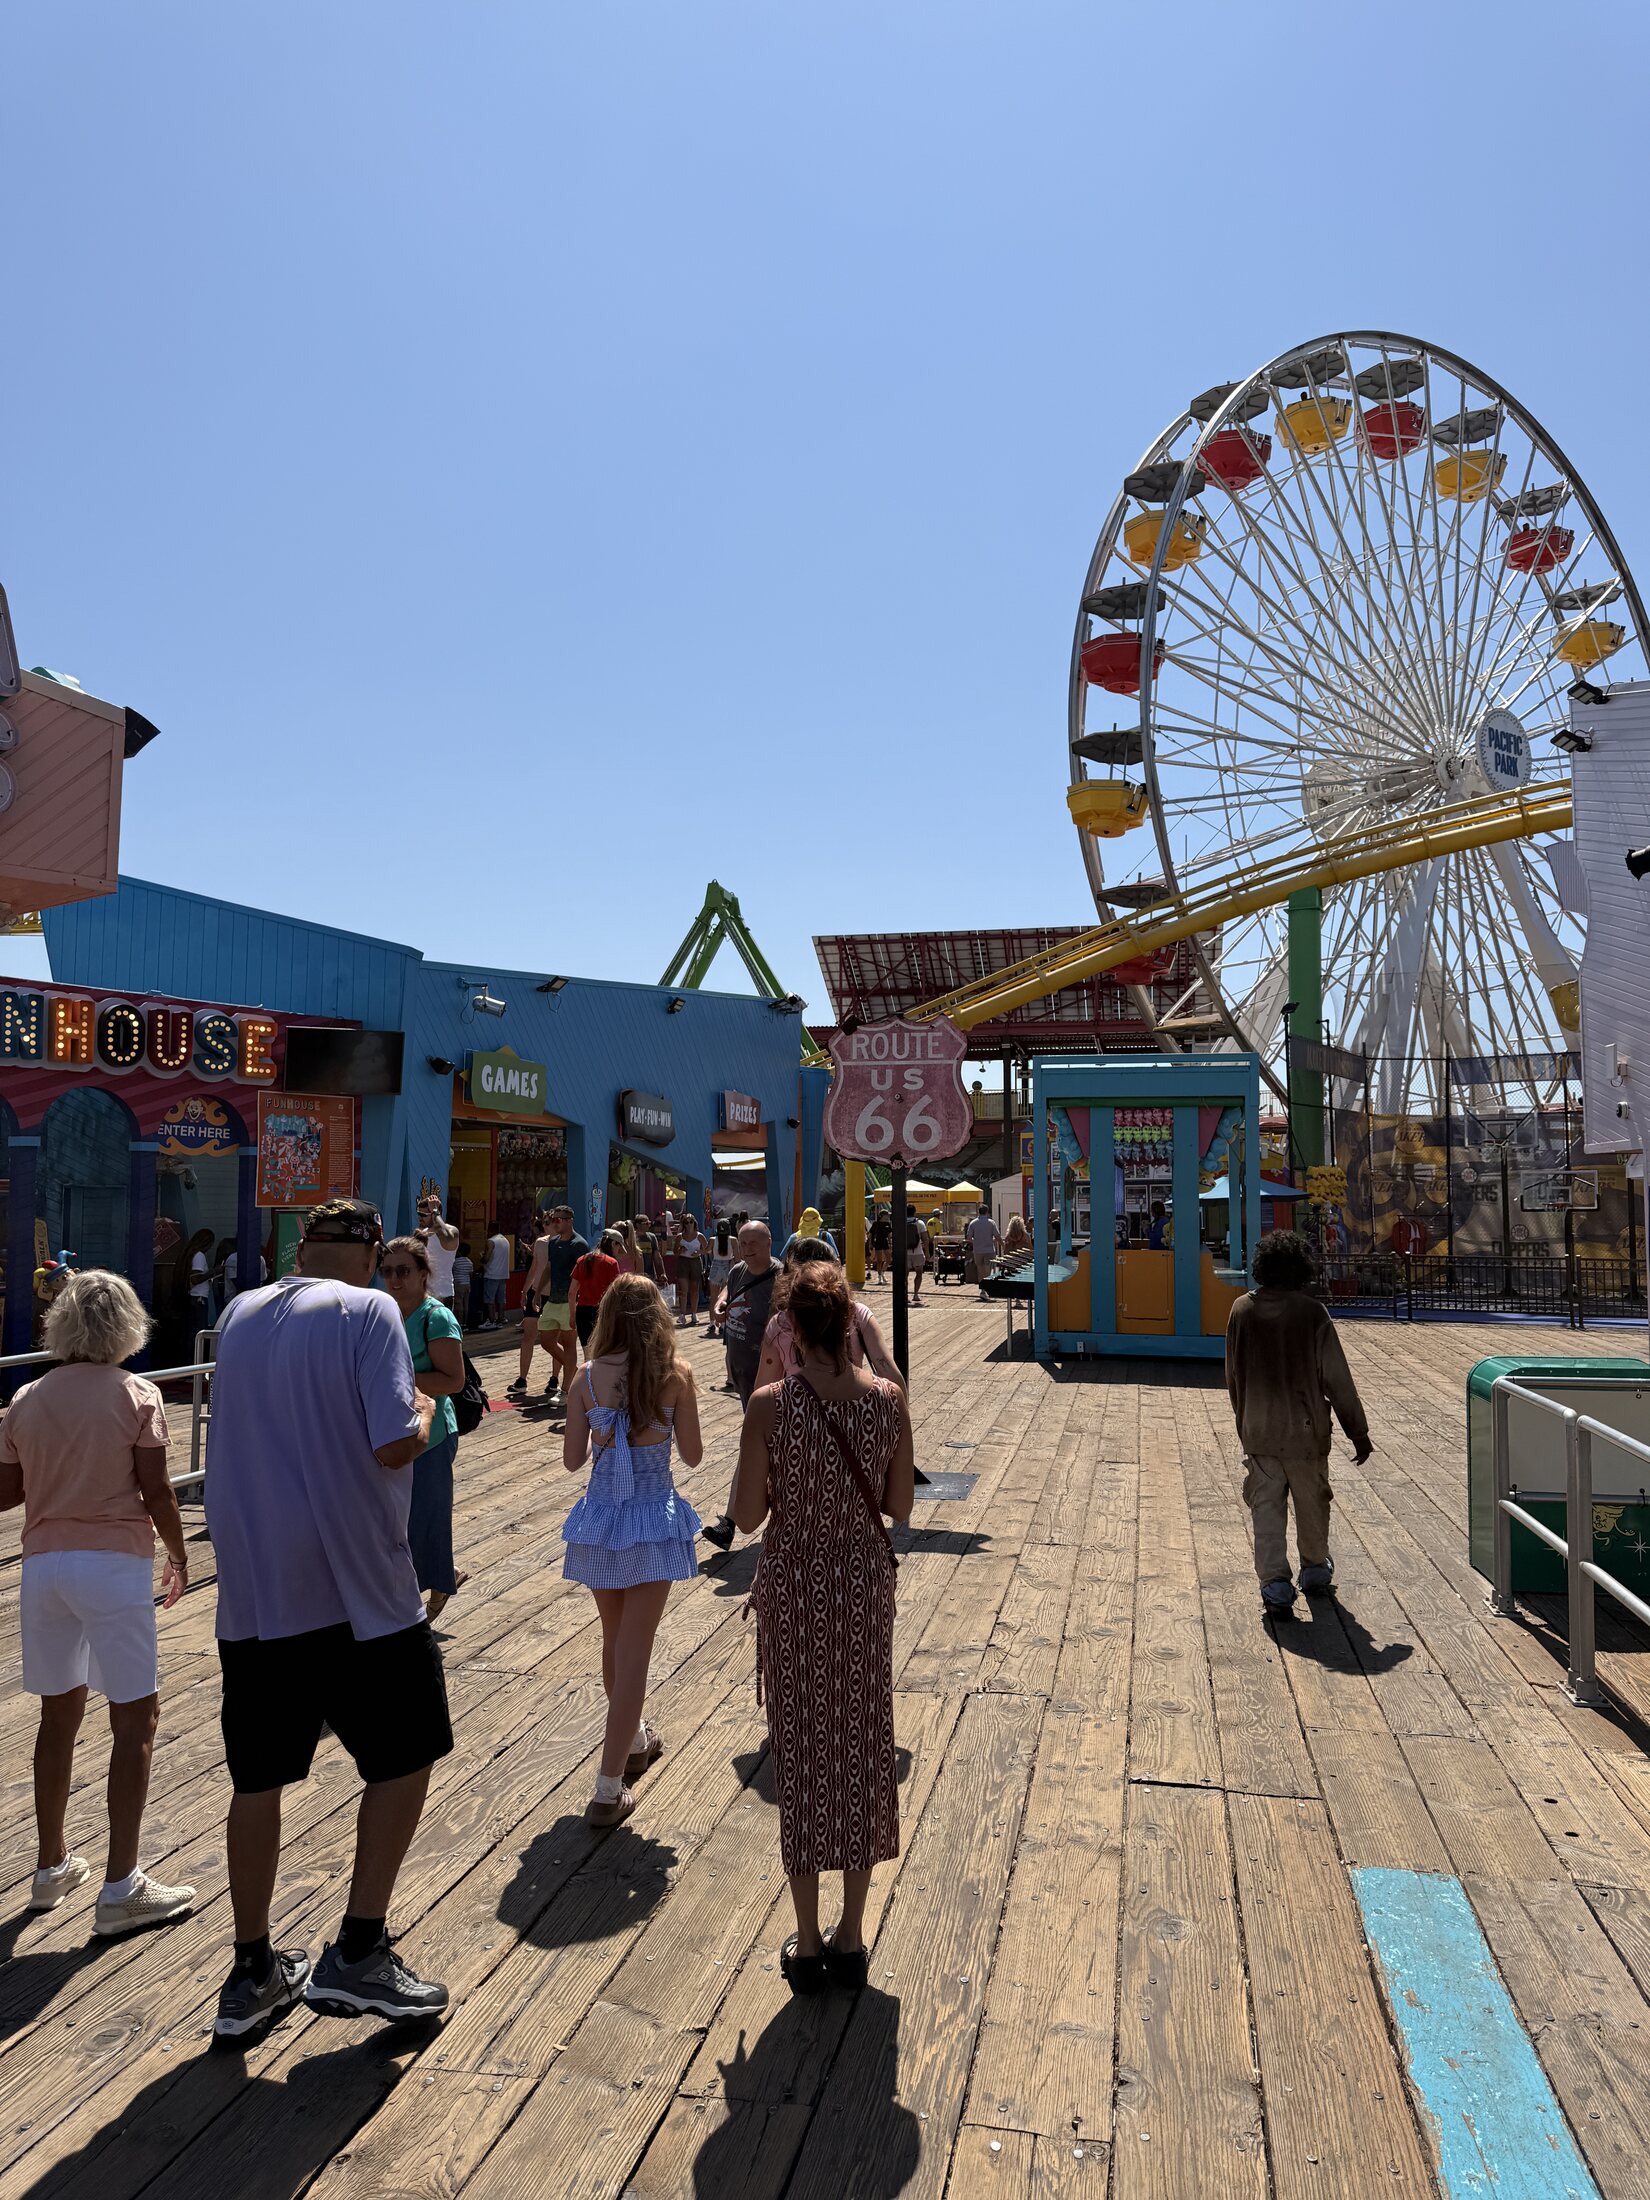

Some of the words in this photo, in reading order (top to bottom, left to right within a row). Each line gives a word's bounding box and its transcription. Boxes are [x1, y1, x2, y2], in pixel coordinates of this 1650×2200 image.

[1488, 727, 1523, 756] PACIFIC
[1494, 751, 1519, 778] PARK
[852, 1032, 944, 1060] ROUTE
[481, 1064, 538, 1100] GAMES
[264, 1096, 321, 1111] FUNHOUSE
[729, 1102, 757, 1125] PRIZES
[157, 1123, 196, 1137] ENTER
[198, 1127, 231, 1139] HERE
[855, 1094, 942, 1152] 66
[282, 1247, 298, 1257] FLAVO
